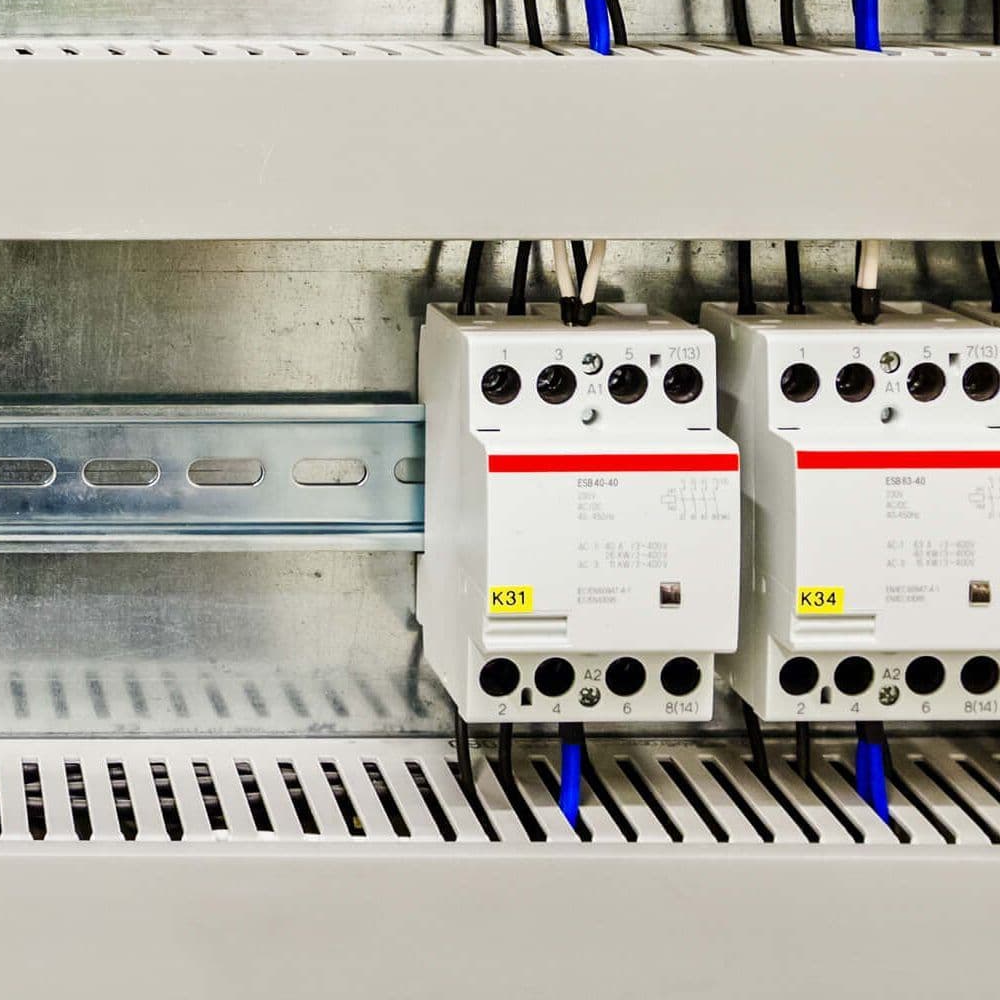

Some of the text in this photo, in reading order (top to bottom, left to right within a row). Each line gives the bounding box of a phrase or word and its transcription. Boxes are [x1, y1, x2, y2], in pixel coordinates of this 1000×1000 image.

[555, 349, 562, 361] 3
[626, 348, 633, 360] 5
[669, 348, 700, 361] 7(13)
[799, 346, 998, 360] 1 3 5 7(13)
[588, 384, 602, 394] A1
[886, 382, 900, 392] A1
[493, 591, 525, 605] K31
[801, 592, 836, 606] K34
[585, 669, 601, 681] A2
[883, 669, 900, 680] A2
[498, 702, 698, 716] 2 4 6 8(14)
[797, 701, 997, 715] 2 4 6 8(14)
